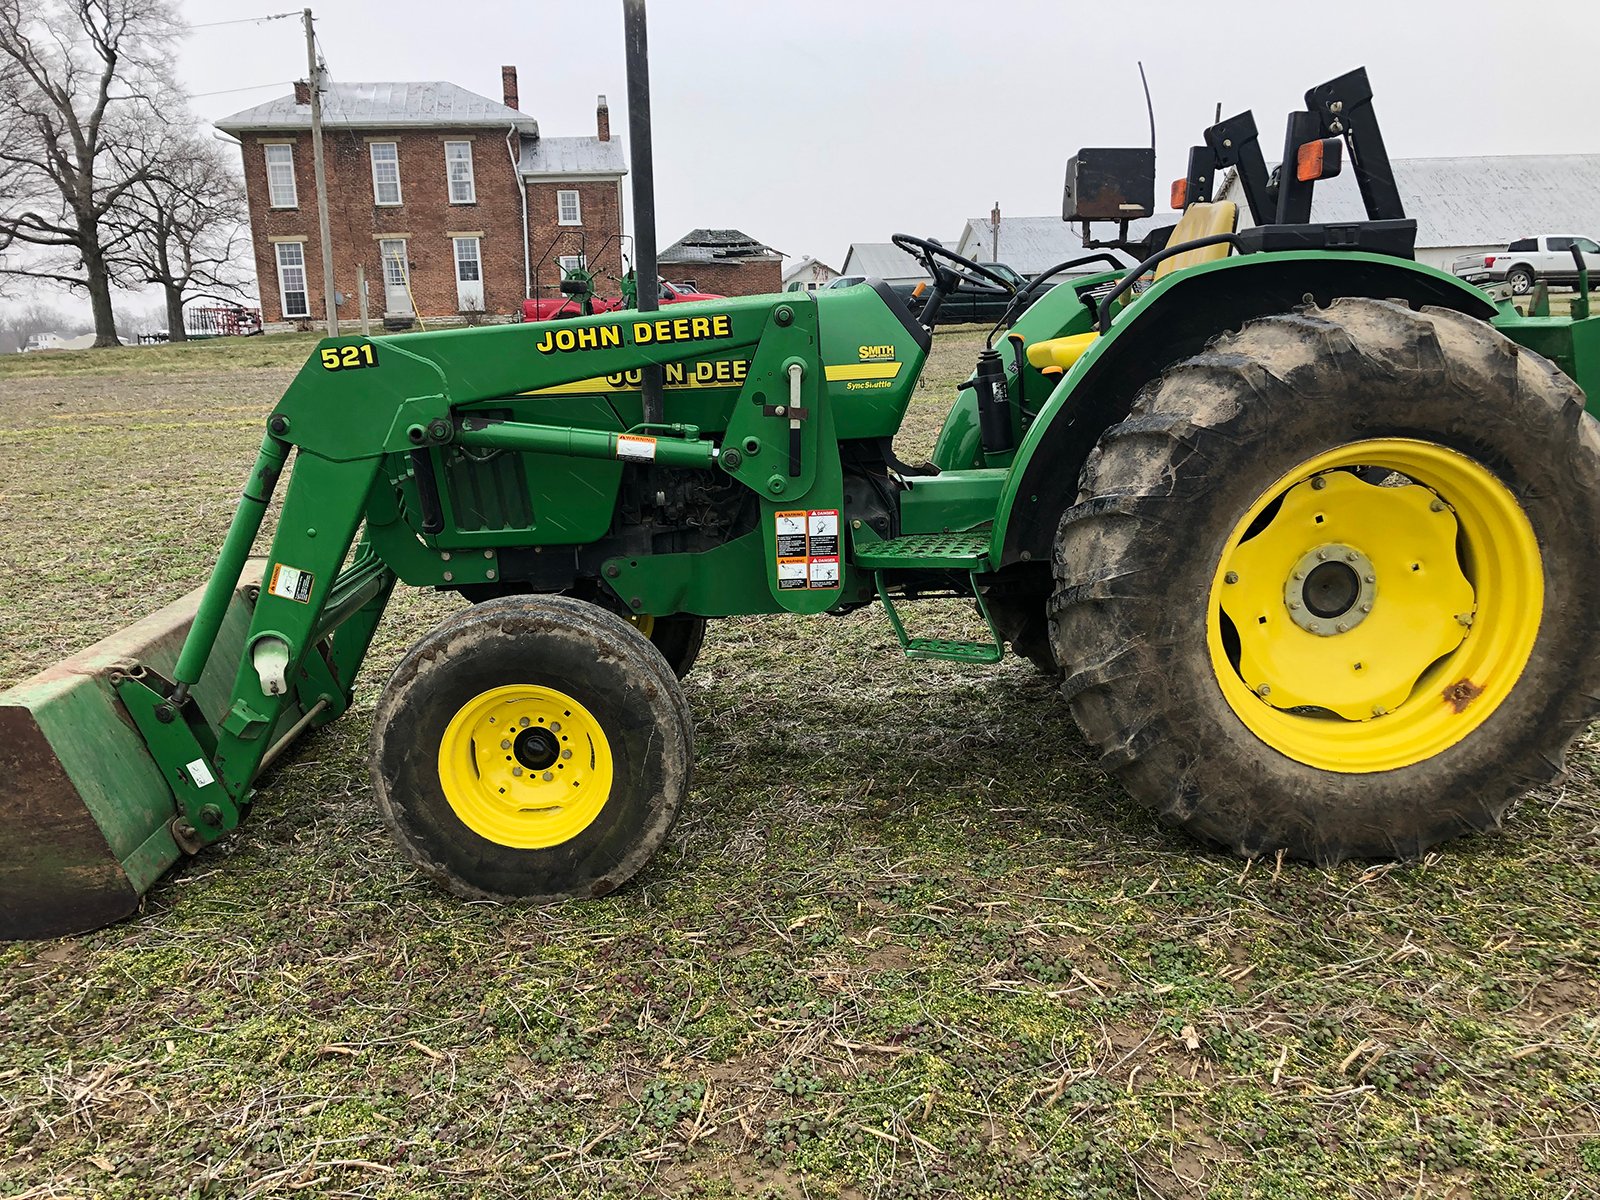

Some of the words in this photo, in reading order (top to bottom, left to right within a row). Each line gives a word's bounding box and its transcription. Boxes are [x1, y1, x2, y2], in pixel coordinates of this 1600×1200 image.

[535, 323, 622, 354] JOHN
[633, 314, 732, 345] DEERE
[320, 344, 377, 370] 521
[858, 345, 895, 358] SMITH
[607, 362, 686, 387] JON
[696, 360, 750, 383] DEE
